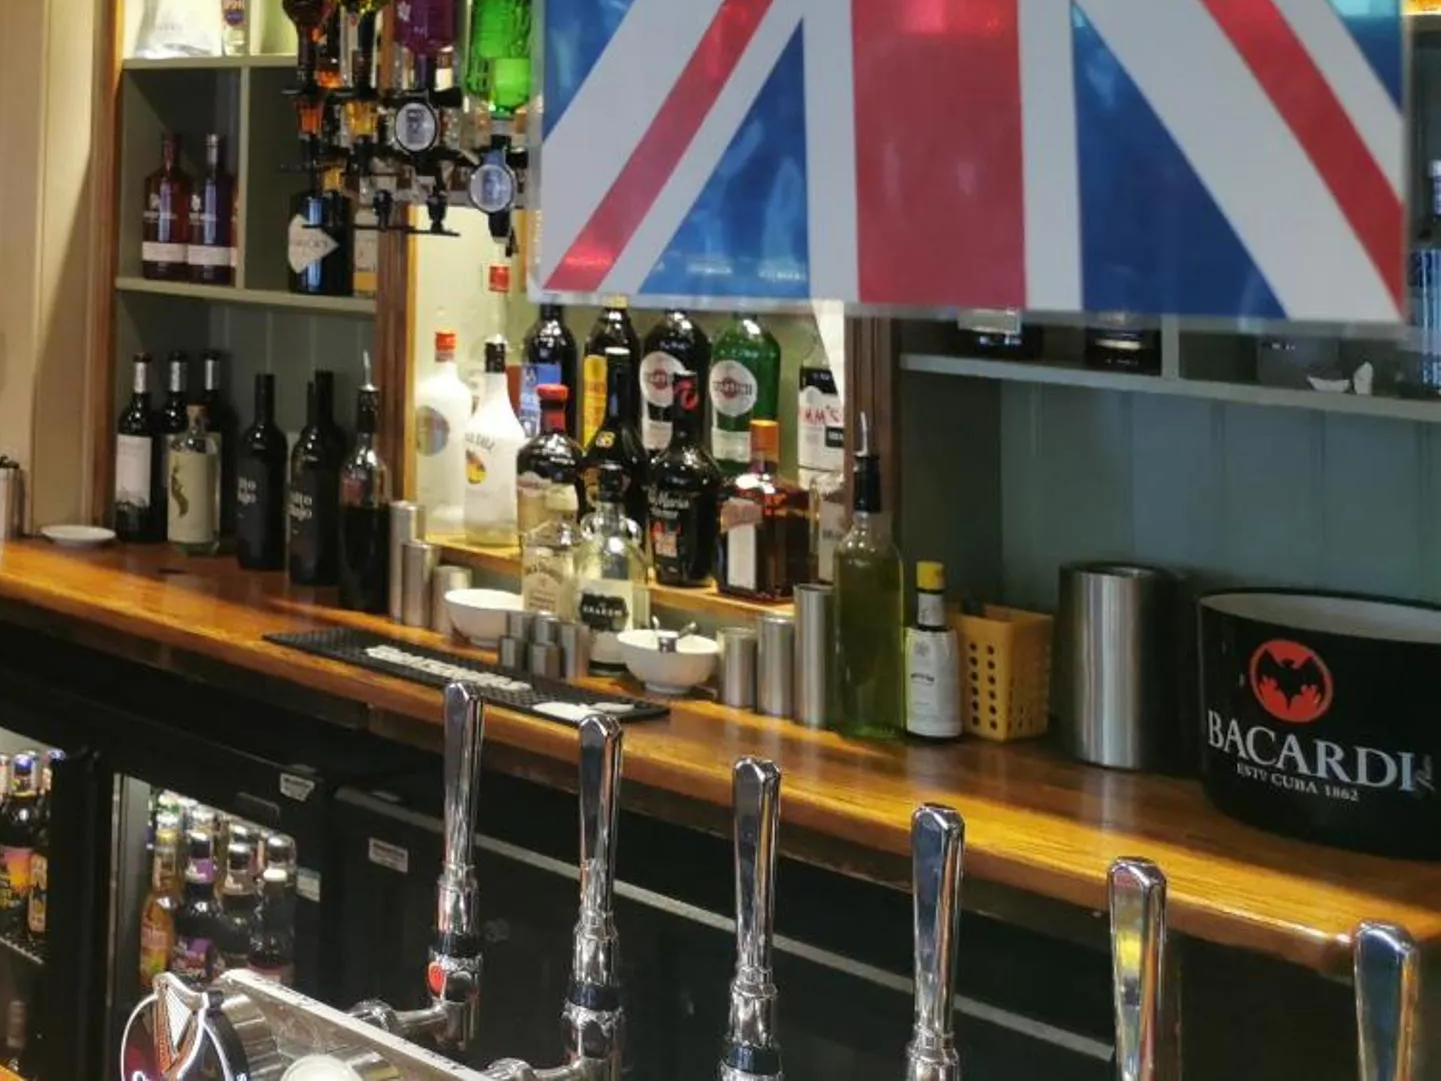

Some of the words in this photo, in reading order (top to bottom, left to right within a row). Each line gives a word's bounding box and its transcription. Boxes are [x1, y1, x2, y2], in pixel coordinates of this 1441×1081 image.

[1207, 709, 1416, 792] BACARDI
[1270, 772, 1319, 795] CUBA
[1324, 784, 1360, 802] 1862
